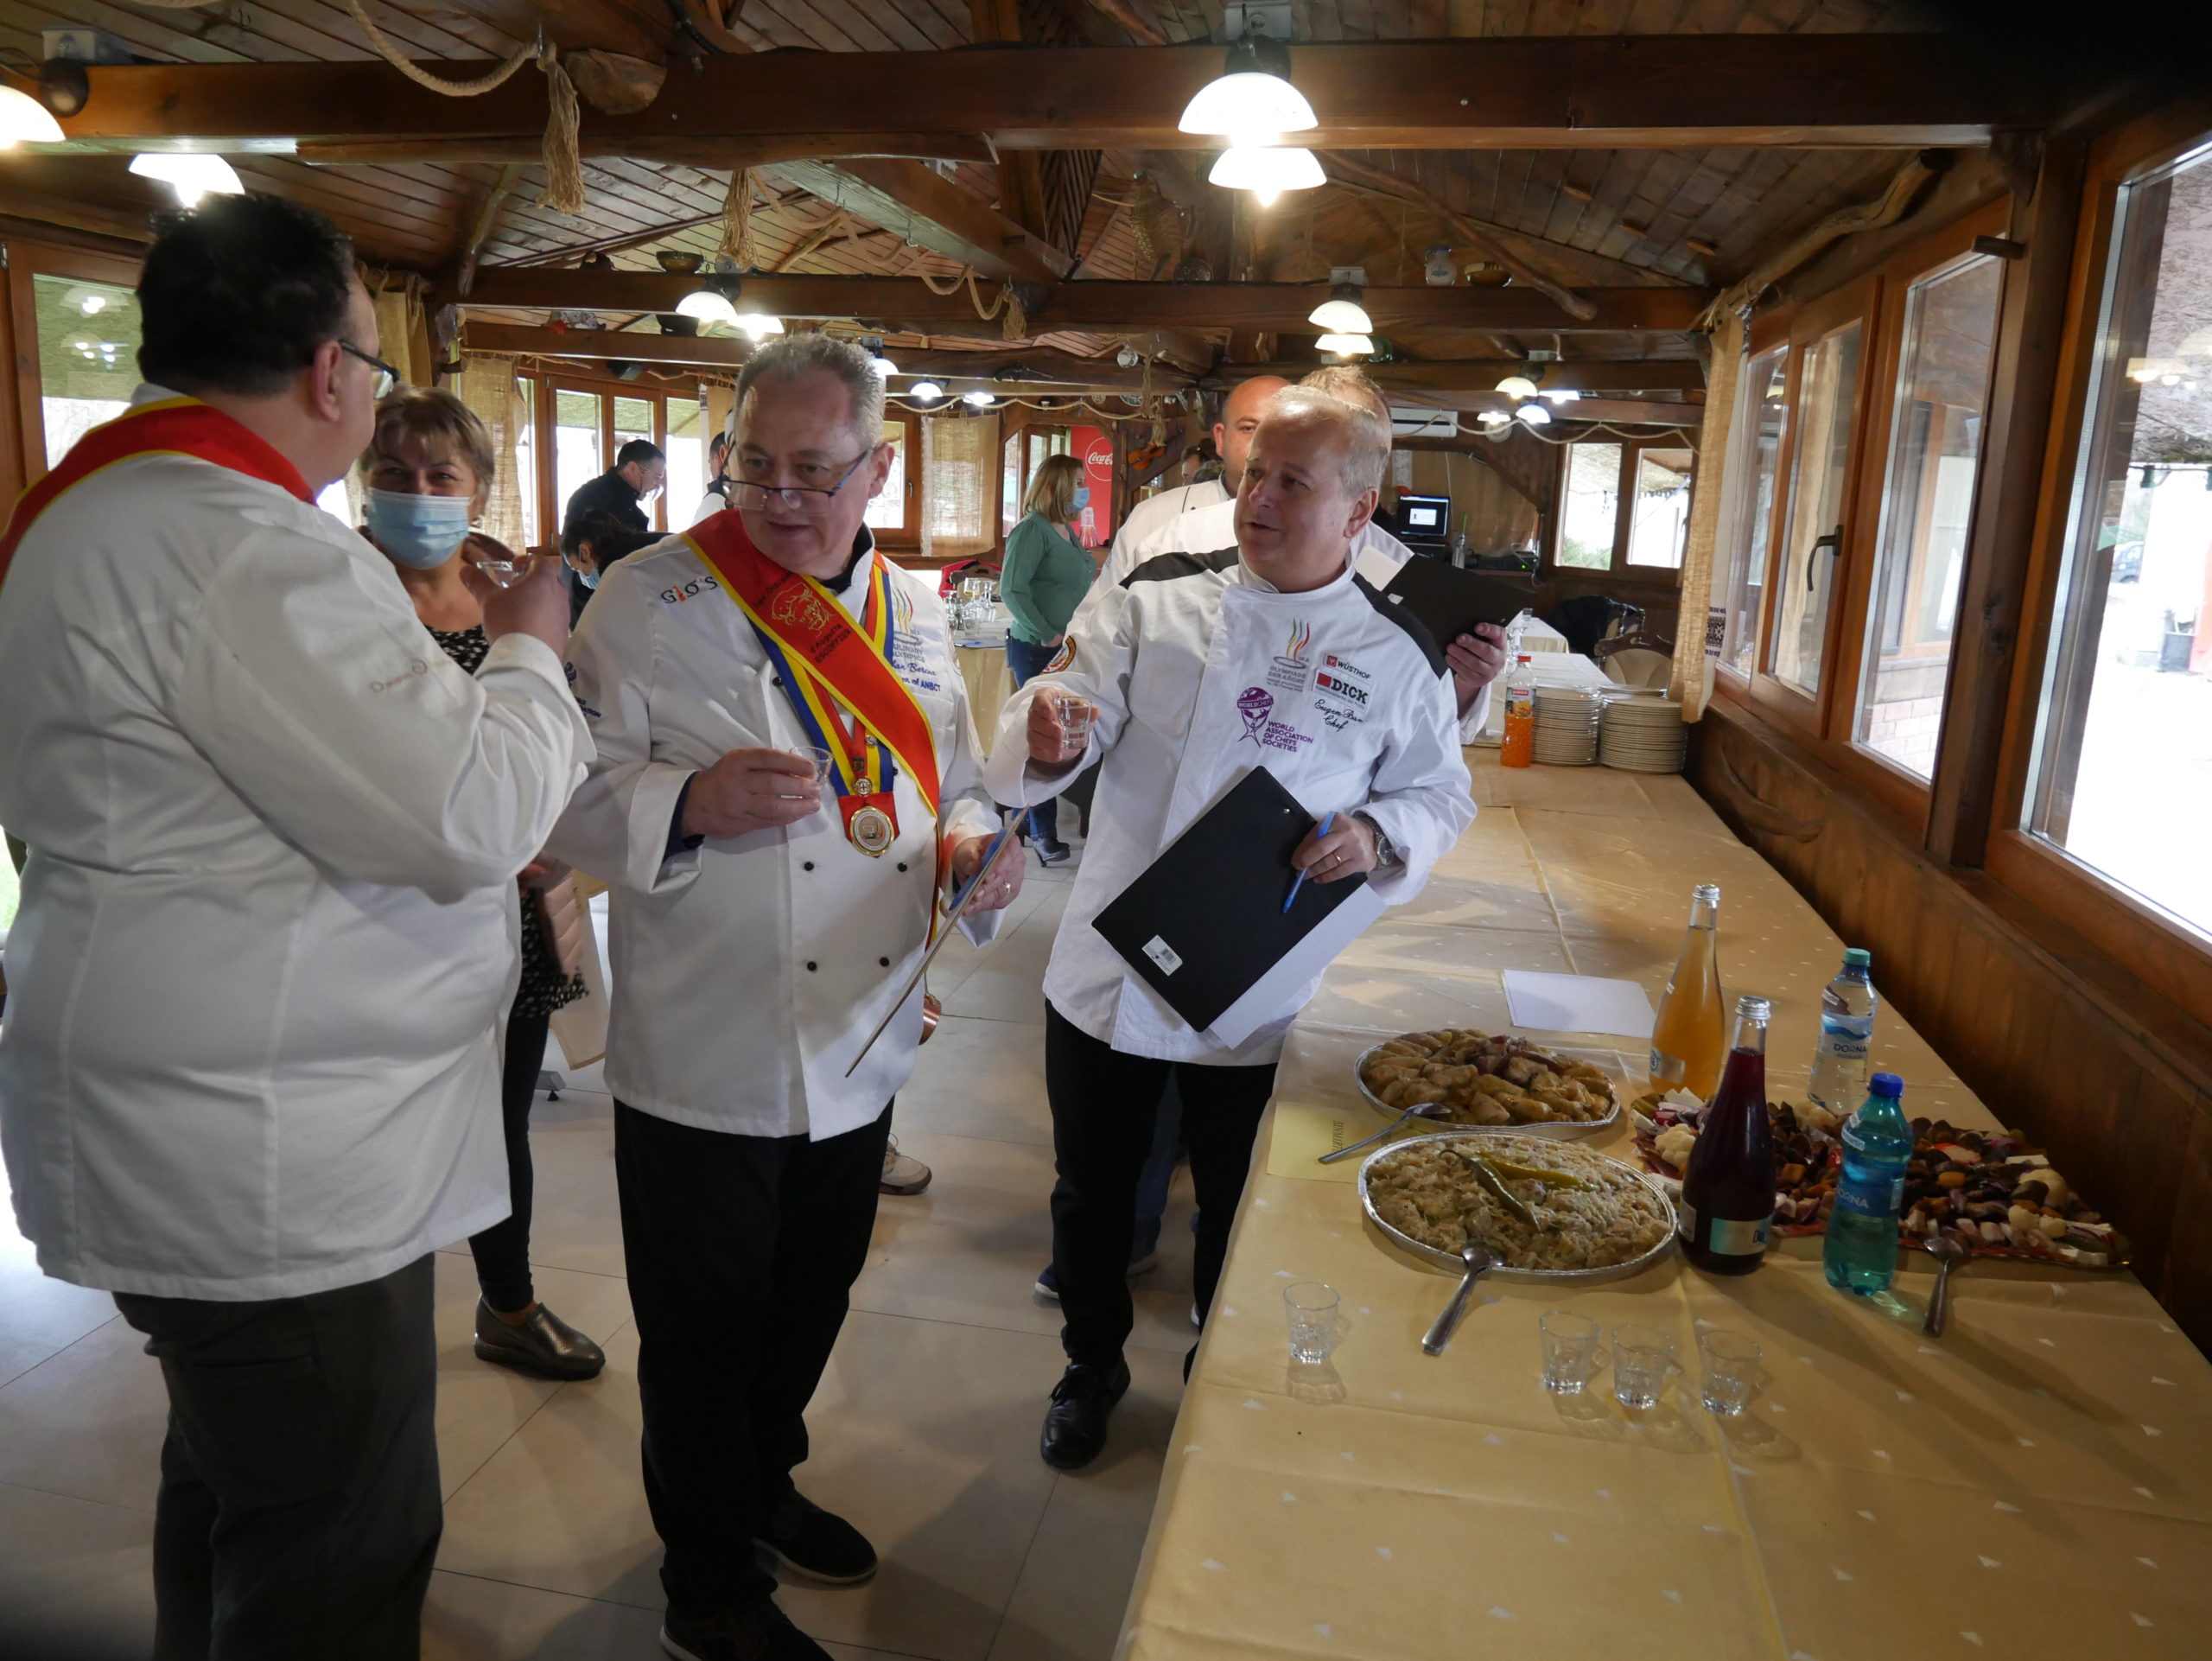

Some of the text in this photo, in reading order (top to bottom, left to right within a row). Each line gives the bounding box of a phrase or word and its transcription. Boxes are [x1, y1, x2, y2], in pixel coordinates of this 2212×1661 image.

[893, 643, 923, 656] ULINARY
[893, 651, 925, 663] LYMPICS
[1338, 660, 1371, 679] WÜSTHOF
[920, 679, 941, 692] ANBCT
[1332, 678, 1368, 704] DICK
[1268, 720, 1295, 732] WORLD
[1324, 715, 1349, 733] Chef
[1266, 727, 1313, 743] ASSOCIATION
[1274, 735, 1297, 746] CHEFS
[1262, 738, 1298, 752] SOCIETIES
[1834, 1043, 1866, 1053] DORNA
